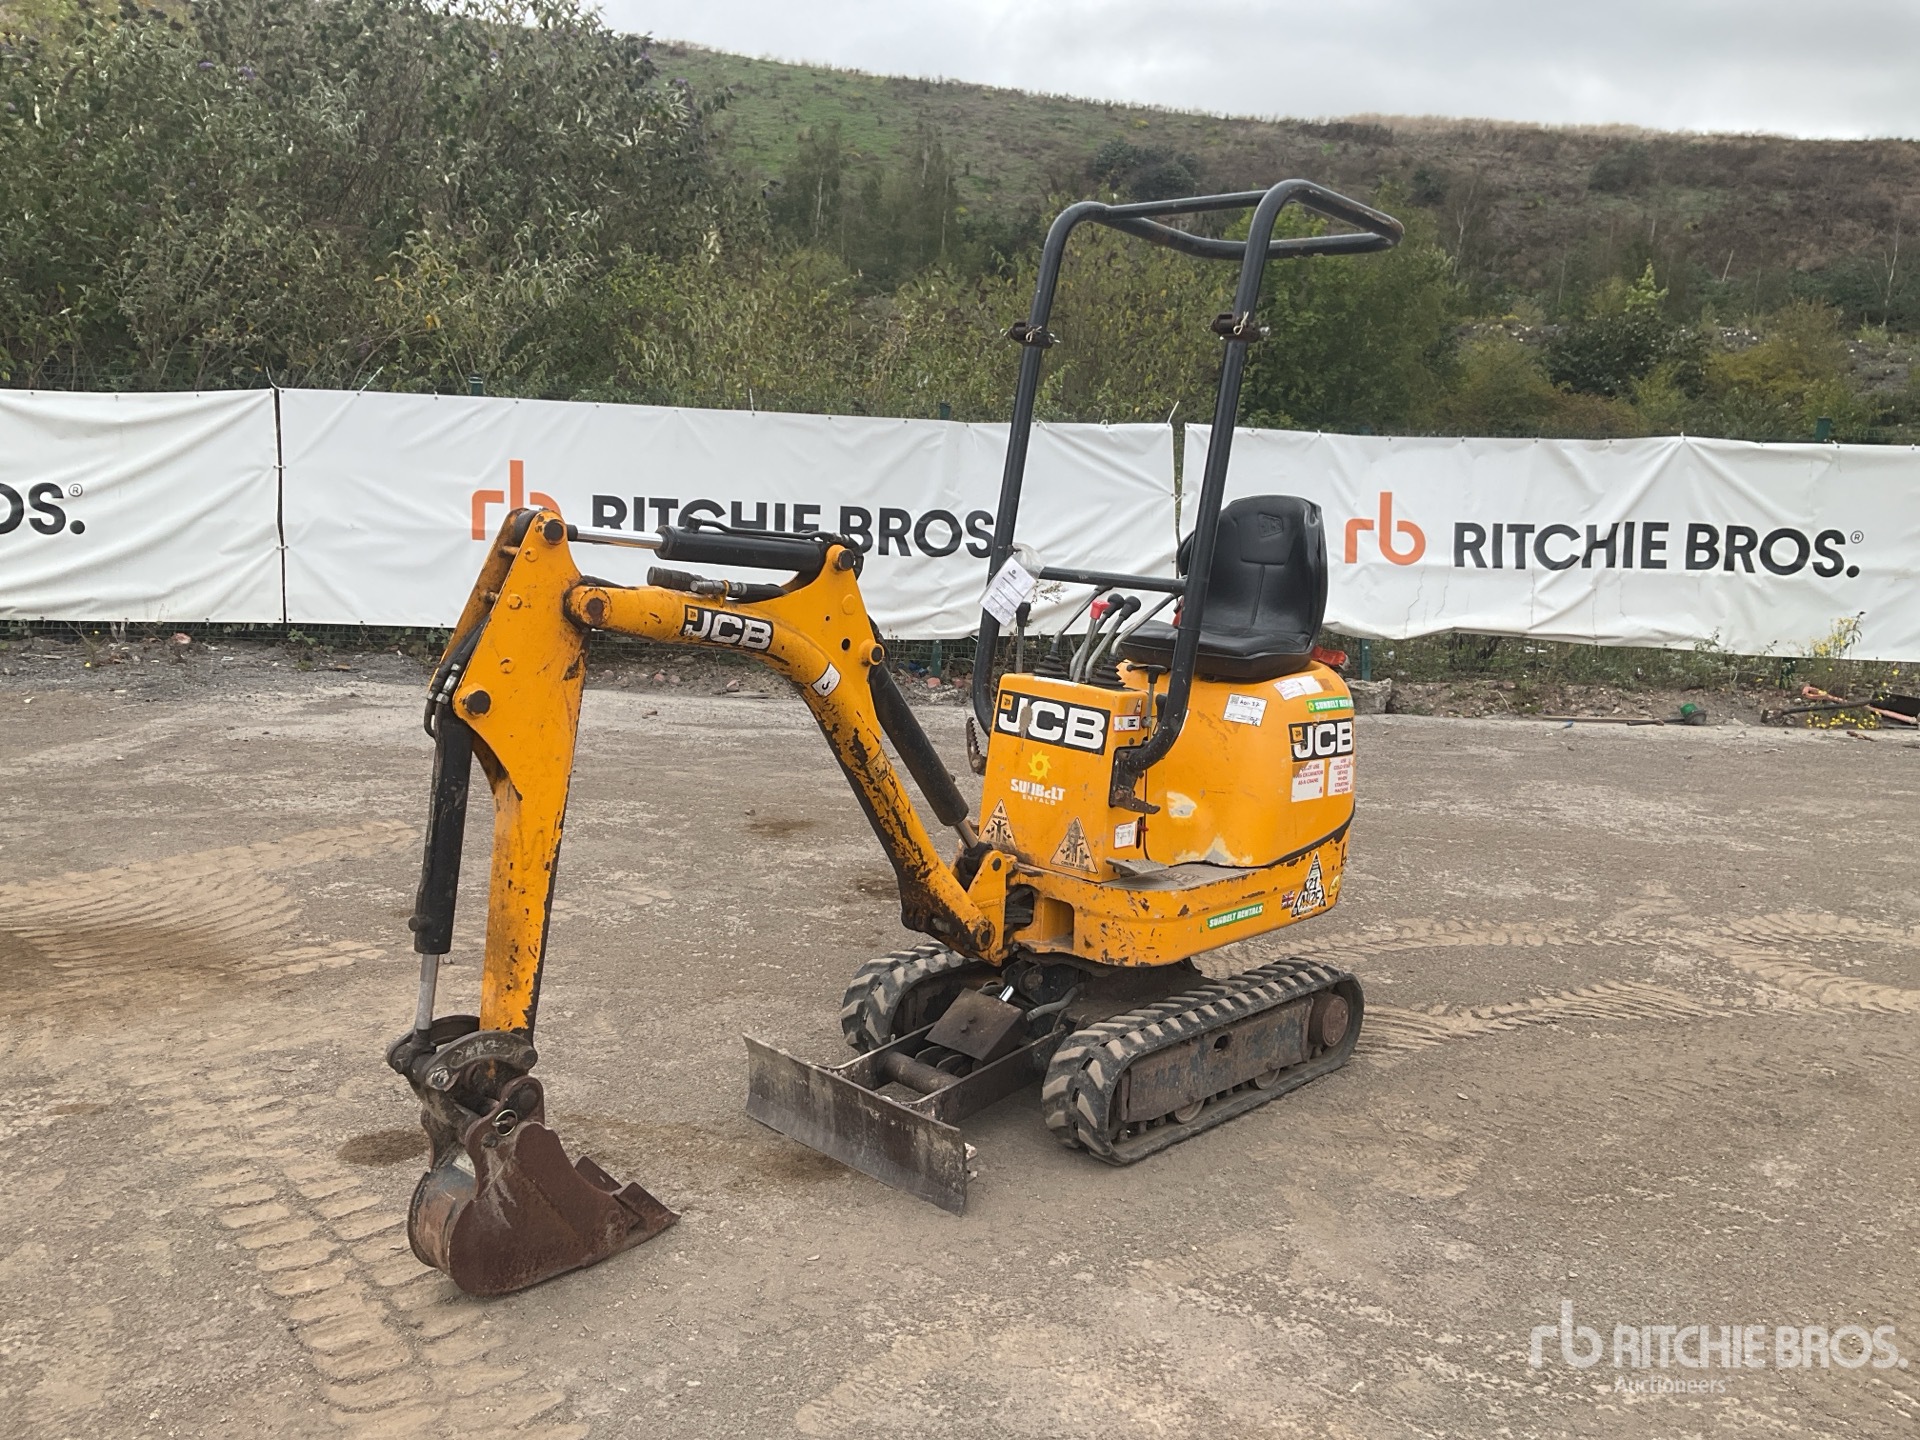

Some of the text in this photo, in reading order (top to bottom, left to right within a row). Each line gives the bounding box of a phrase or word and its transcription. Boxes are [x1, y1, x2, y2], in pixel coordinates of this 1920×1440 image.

[1345, 492, 1426, 566] rb
[1454, 522, 1669, 570] RITCHIE
[684, 610, 772, 650] JCB
[998, 697, 1105, 749] JCB
[1294, 722, 1353, 758] JCB
[1209, 905, 1263, 927] SUNBELT RENTALS
